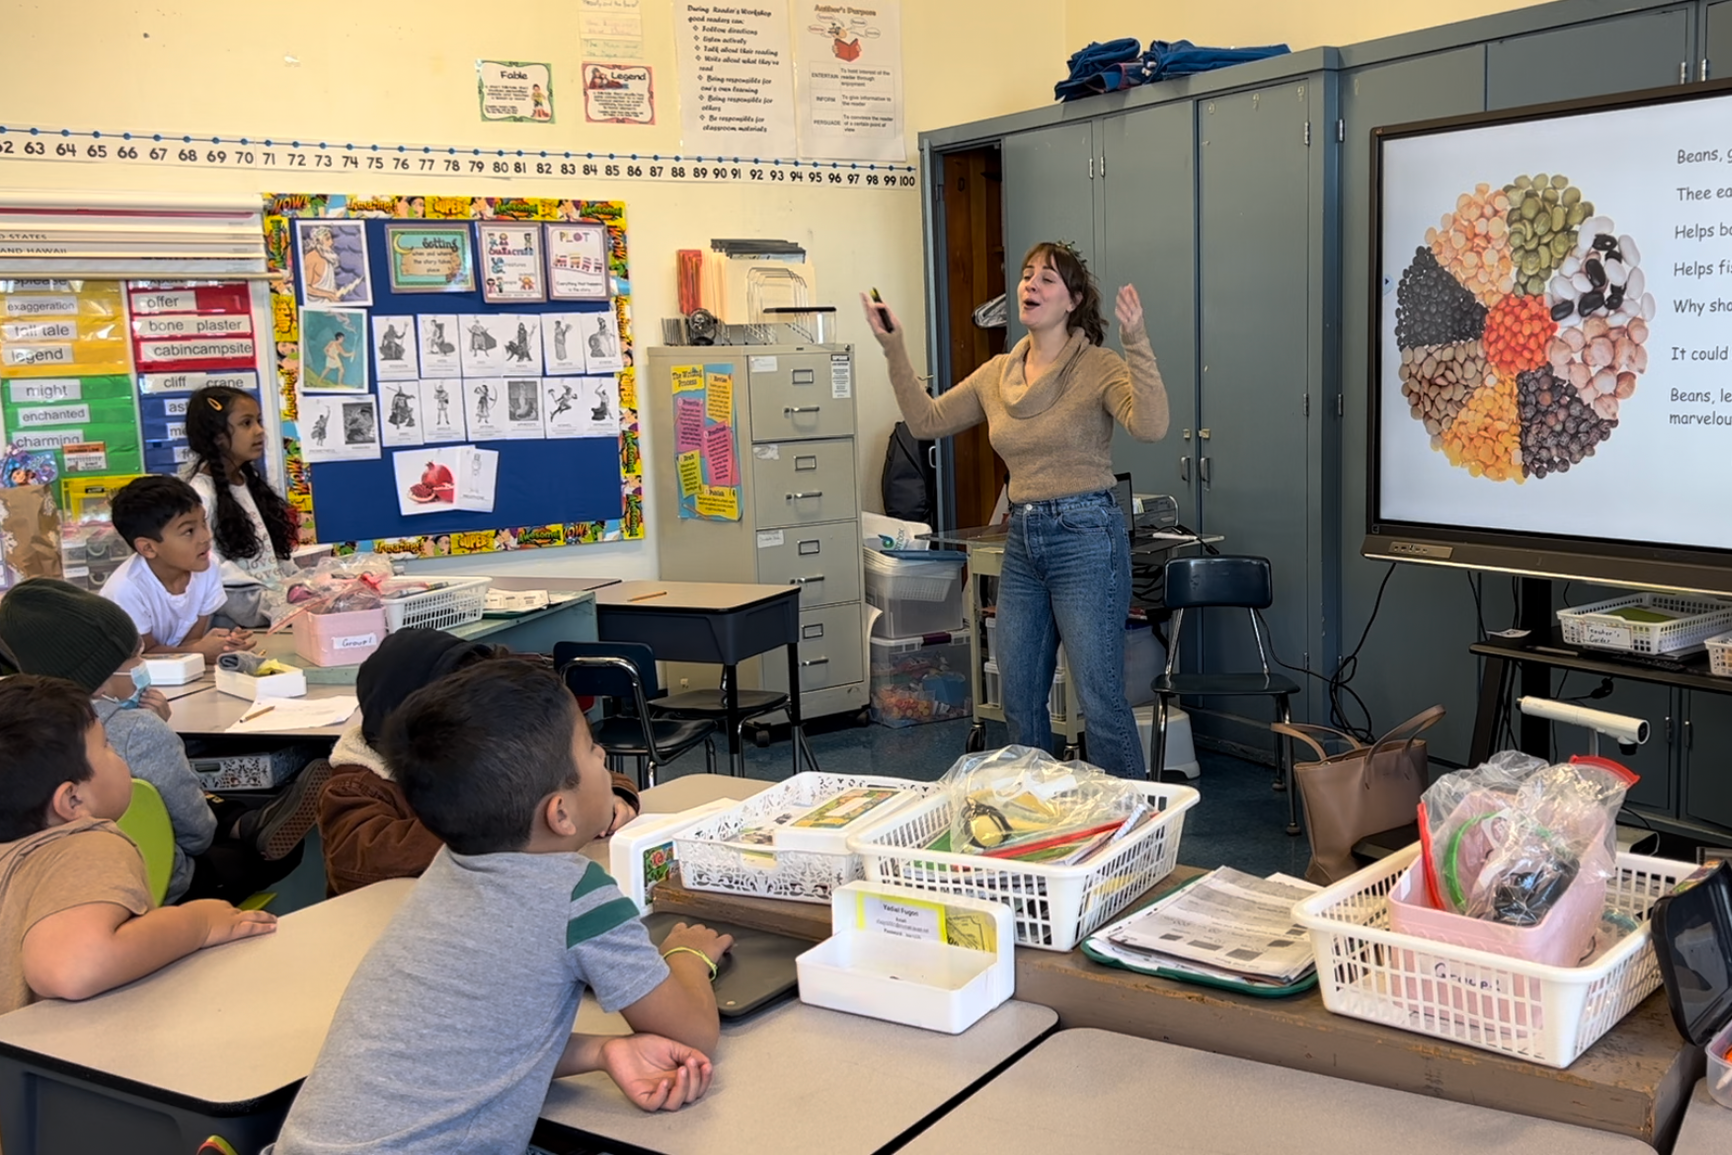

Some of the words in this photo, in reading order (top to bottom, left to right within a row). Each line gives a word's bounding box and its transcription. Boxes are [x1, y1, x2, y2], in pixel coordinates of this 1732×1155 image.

[688, 5, 709, 14] During
[712, 6, 740, 14] Reader's
[741, 8, 772, 17] Workshop
[848, 7, 876, 16] Purpose
[500, 70, 528, 80] Fable
[611, 72, 646, 82] Legend
[706, 75, 724, 83] Being
[733, 86, 758, 94] learning
[708, 94, 726, 103] Being
[1677, 149, 1723, 164] Beans,
[23, 141, 46, 156] 63
[55, 142, 78, 158] 64
[86, 144, 108, 159] 65
[116, 145, 139, 160] 66
[148, 147, 169, 162] 67
[177, 148, 198, 163] 68
[206, 149, 228, 164] 69
[234, 150, 255, 165] 70
[262, 151, 276, 166] 71
[286, 152, 307, 167] 72
[314, 154, 333, 168] 73
[341, 154, 359, 169] 74
[366, 156, 384, 170] 75
[392, 157, 410, 171] 76
[418, 158, 436, 171] 77
[443, 158, 461, 173] 78
[468, 159, 485, 173] 79
[492, 160, 510, 174] 80
[513, 161, 527, 174] 81
[535, 162, 553, 175] 82
[560, 162, 577, 176] 83
[582, 163, 599, 176] 84
[604, 164, 621, 177] 85
[626, 164, 643, 178] 86
[648, 165, 664, 178] 87
[670, 166, 687, 179] 88
[692, 166, 709, 179] 89
[712, 167, 728, 180] 90
[729, 168, 742, 181] 91
[749, 168, 765, 181] 92
[769, 169, 785, 182] 93
[789, 170, 804, 183] 94
[807, 171, 823, 184] 95
[827, 172, 843, 184] 96
[846, 172, 861, 185] 97
[865, 173, 880, 186] 98
[883, 174, 898, 188] 99
[898, 174, 916, 188] 100
[1676, 187, 1712, 201] Thee
[560, 232, 590, 242] PLOT
[1675, 223, 1715, 242] Helps
[1674, 261, 1713, 280] Helps
[8, 301, 75, 312] exaggeration
[147, 296, 179, 309] offer
[1673, 299, 1705, 317] Why
[149, 320, 184, 332] bone
[197, 320, 242, 333] plaster
[12, 348, 64, 364] legend
[1672, 347, 1686, 360] It
[1691, 346, 1728, 361] could
[164, 376, 186, 388] cliff
[206, 378, 244, 387] crane
[27, 385, 68, 398] might
[1670, 387, 1715, 404] Beans,
[23, 409, 85, 422] enchanted
[16, 436, 80, 448] charming
[1587, 626, 1620, 638] Teacher's
[342, 638, 367, 647] Group
